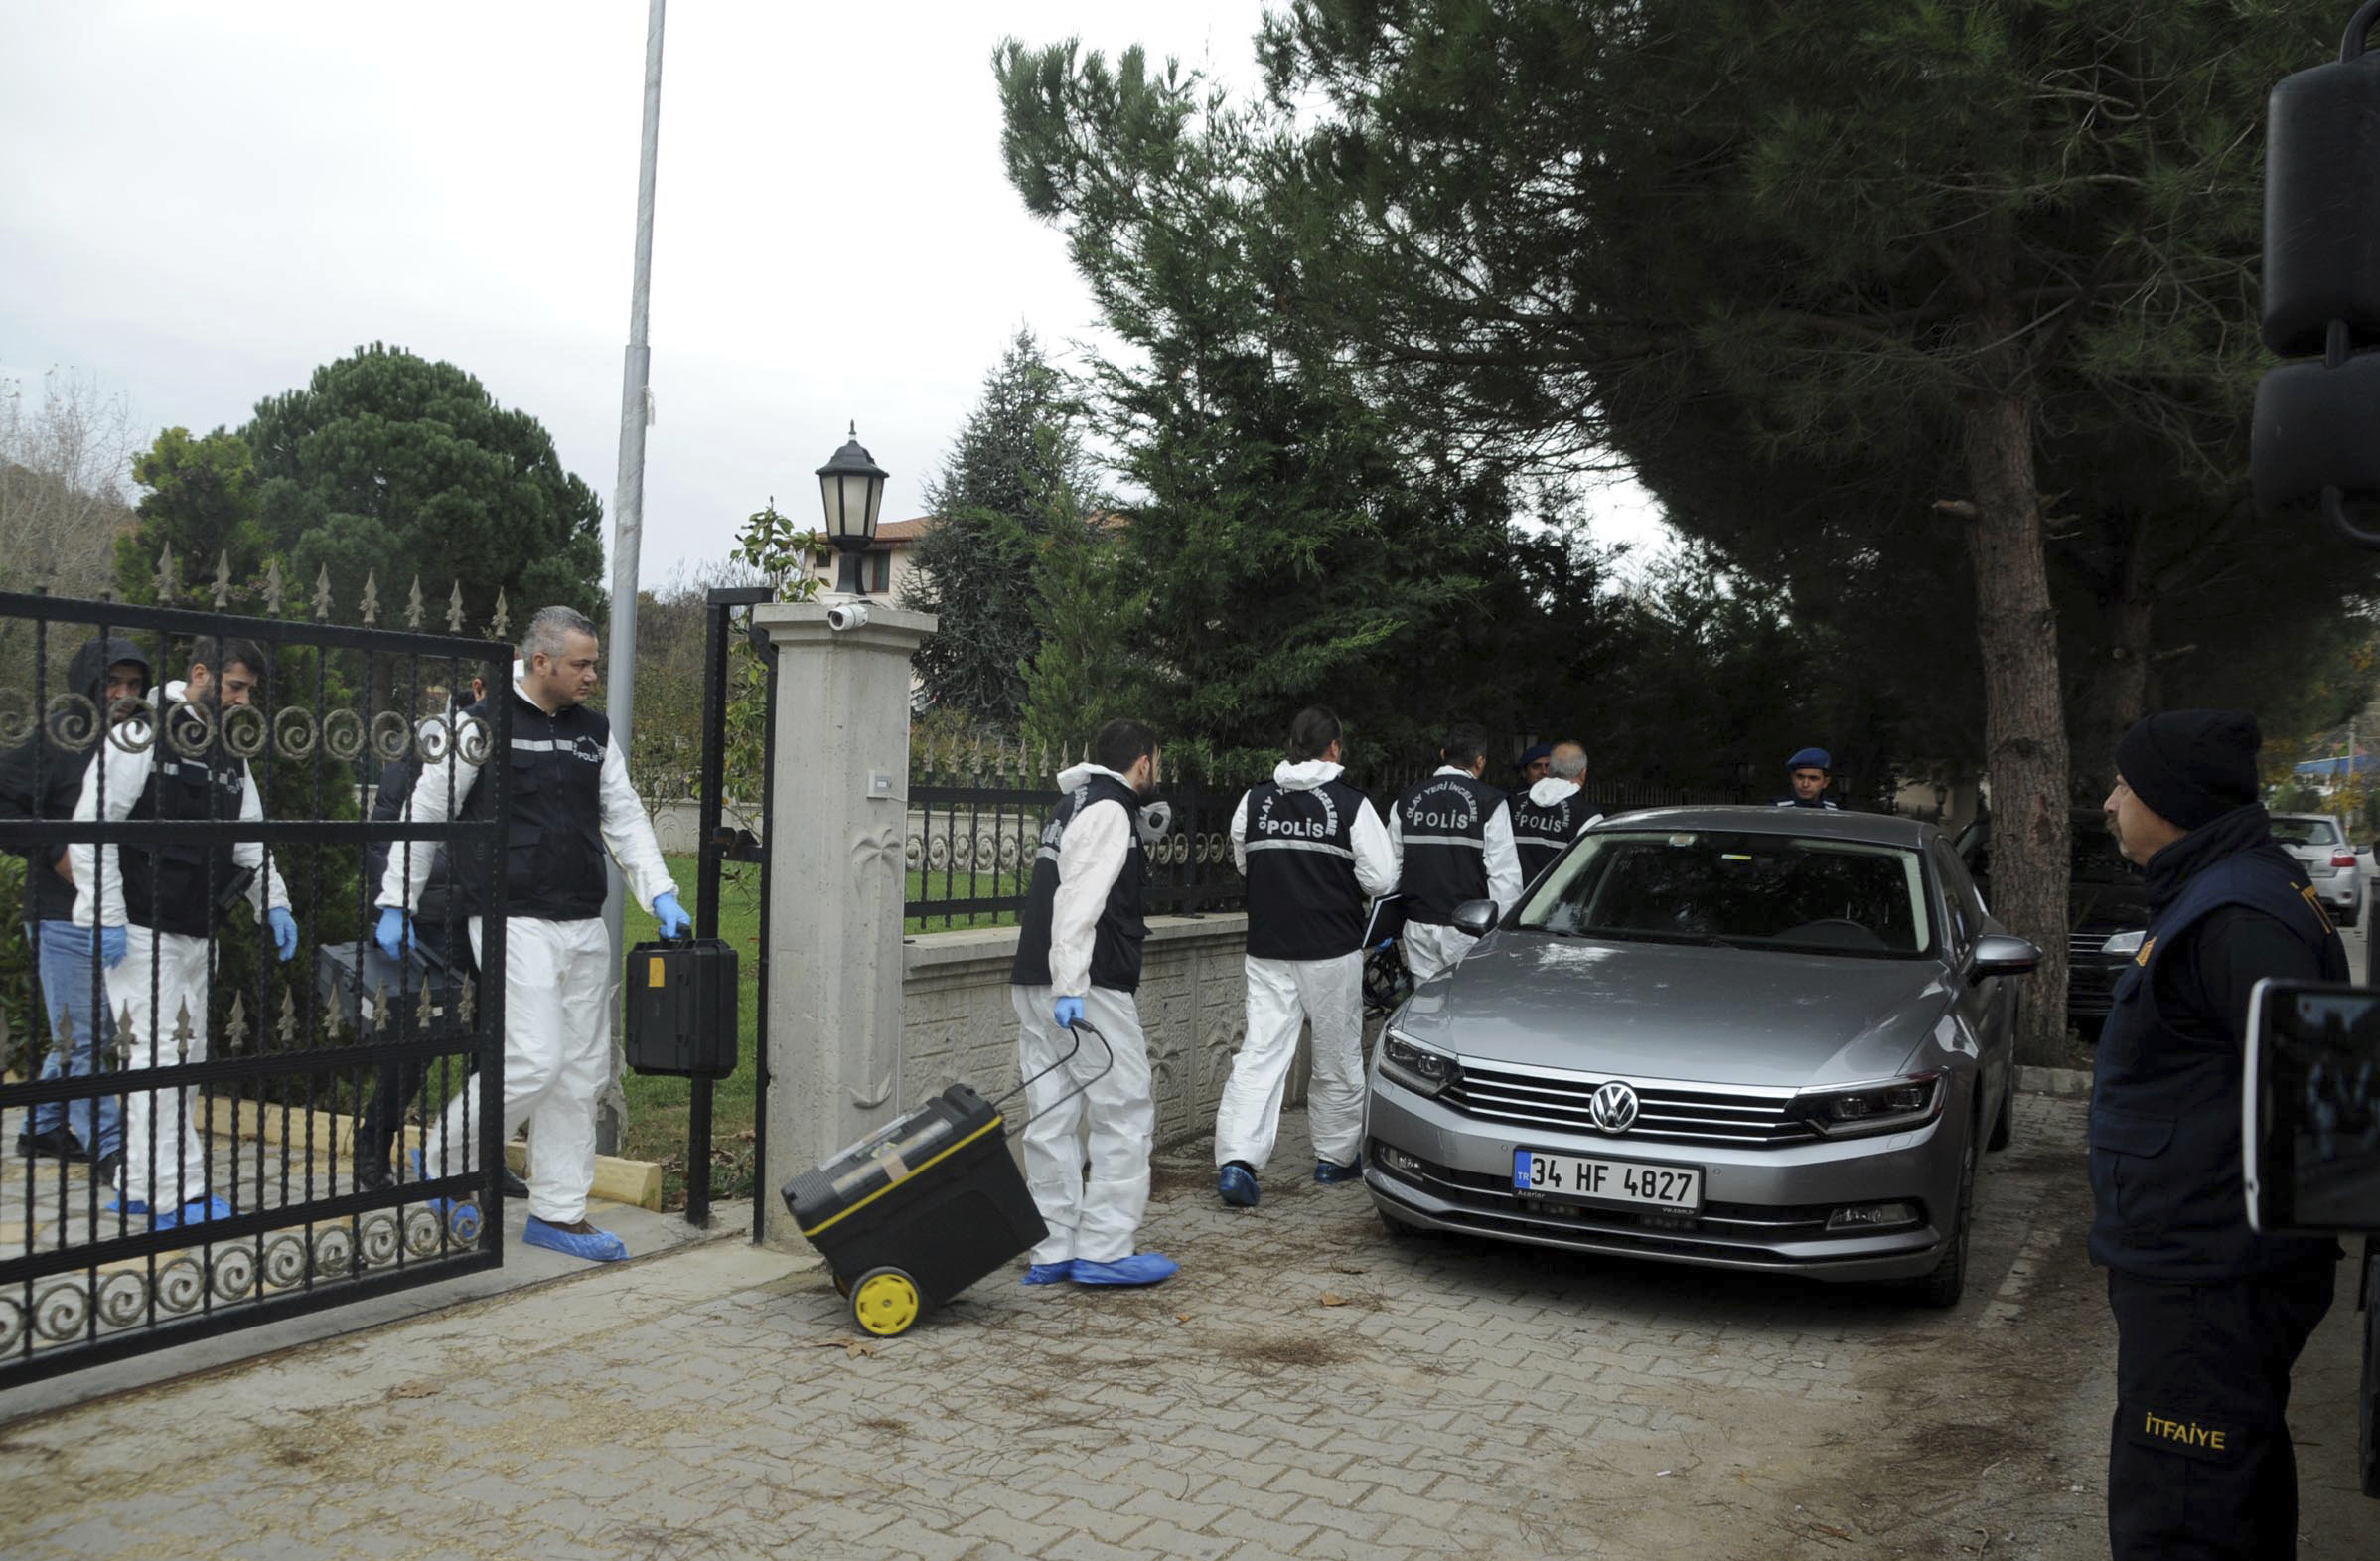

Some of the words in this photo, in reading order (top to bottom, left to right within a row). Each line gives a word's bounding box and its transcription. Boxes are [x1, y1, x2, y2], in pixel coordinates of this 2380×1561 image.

[1258, 795, 1273, 830] OLAY
[1406, 793, 1422, 819] OLAY
[1423, 780, 1448, 795] YERİ
[1449, 781, 1478, 823] İNCELEME
[1266, 817, 1324, 838] POLİS
[1413, 809, 1469, 829] POLİS
[1520, 814, 1562, 833] POLİS
[1518, 1171, 1530, 1182] TR
[1531, 1158, 1562, 1188] 34
[1575, 1162, 1609, 1193] HF
[1623, 1168, 1693, 1202] 4827
[2146, 1411, 2225, 1450] İTFAİYE
